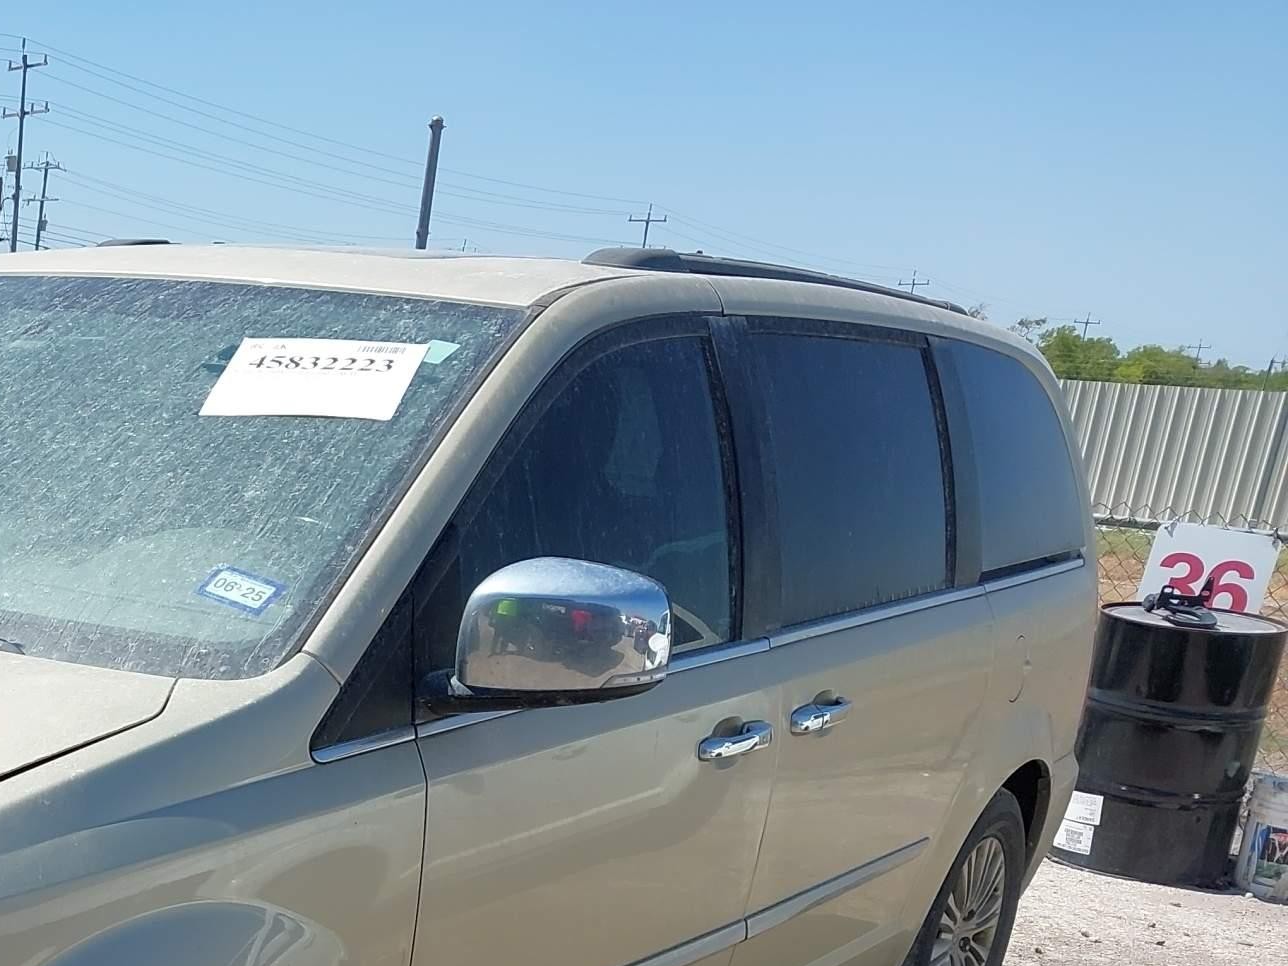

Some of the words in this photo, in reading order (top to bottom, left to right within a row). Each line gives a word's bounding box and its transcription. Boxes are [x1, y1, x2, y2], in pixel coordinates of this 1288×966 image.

[248, 355, 394, 372] 45832223
[213, 577, 238, 593] 06
[239, 587, 267, 602] 25
[1159, 552, 1255, 613] 36
